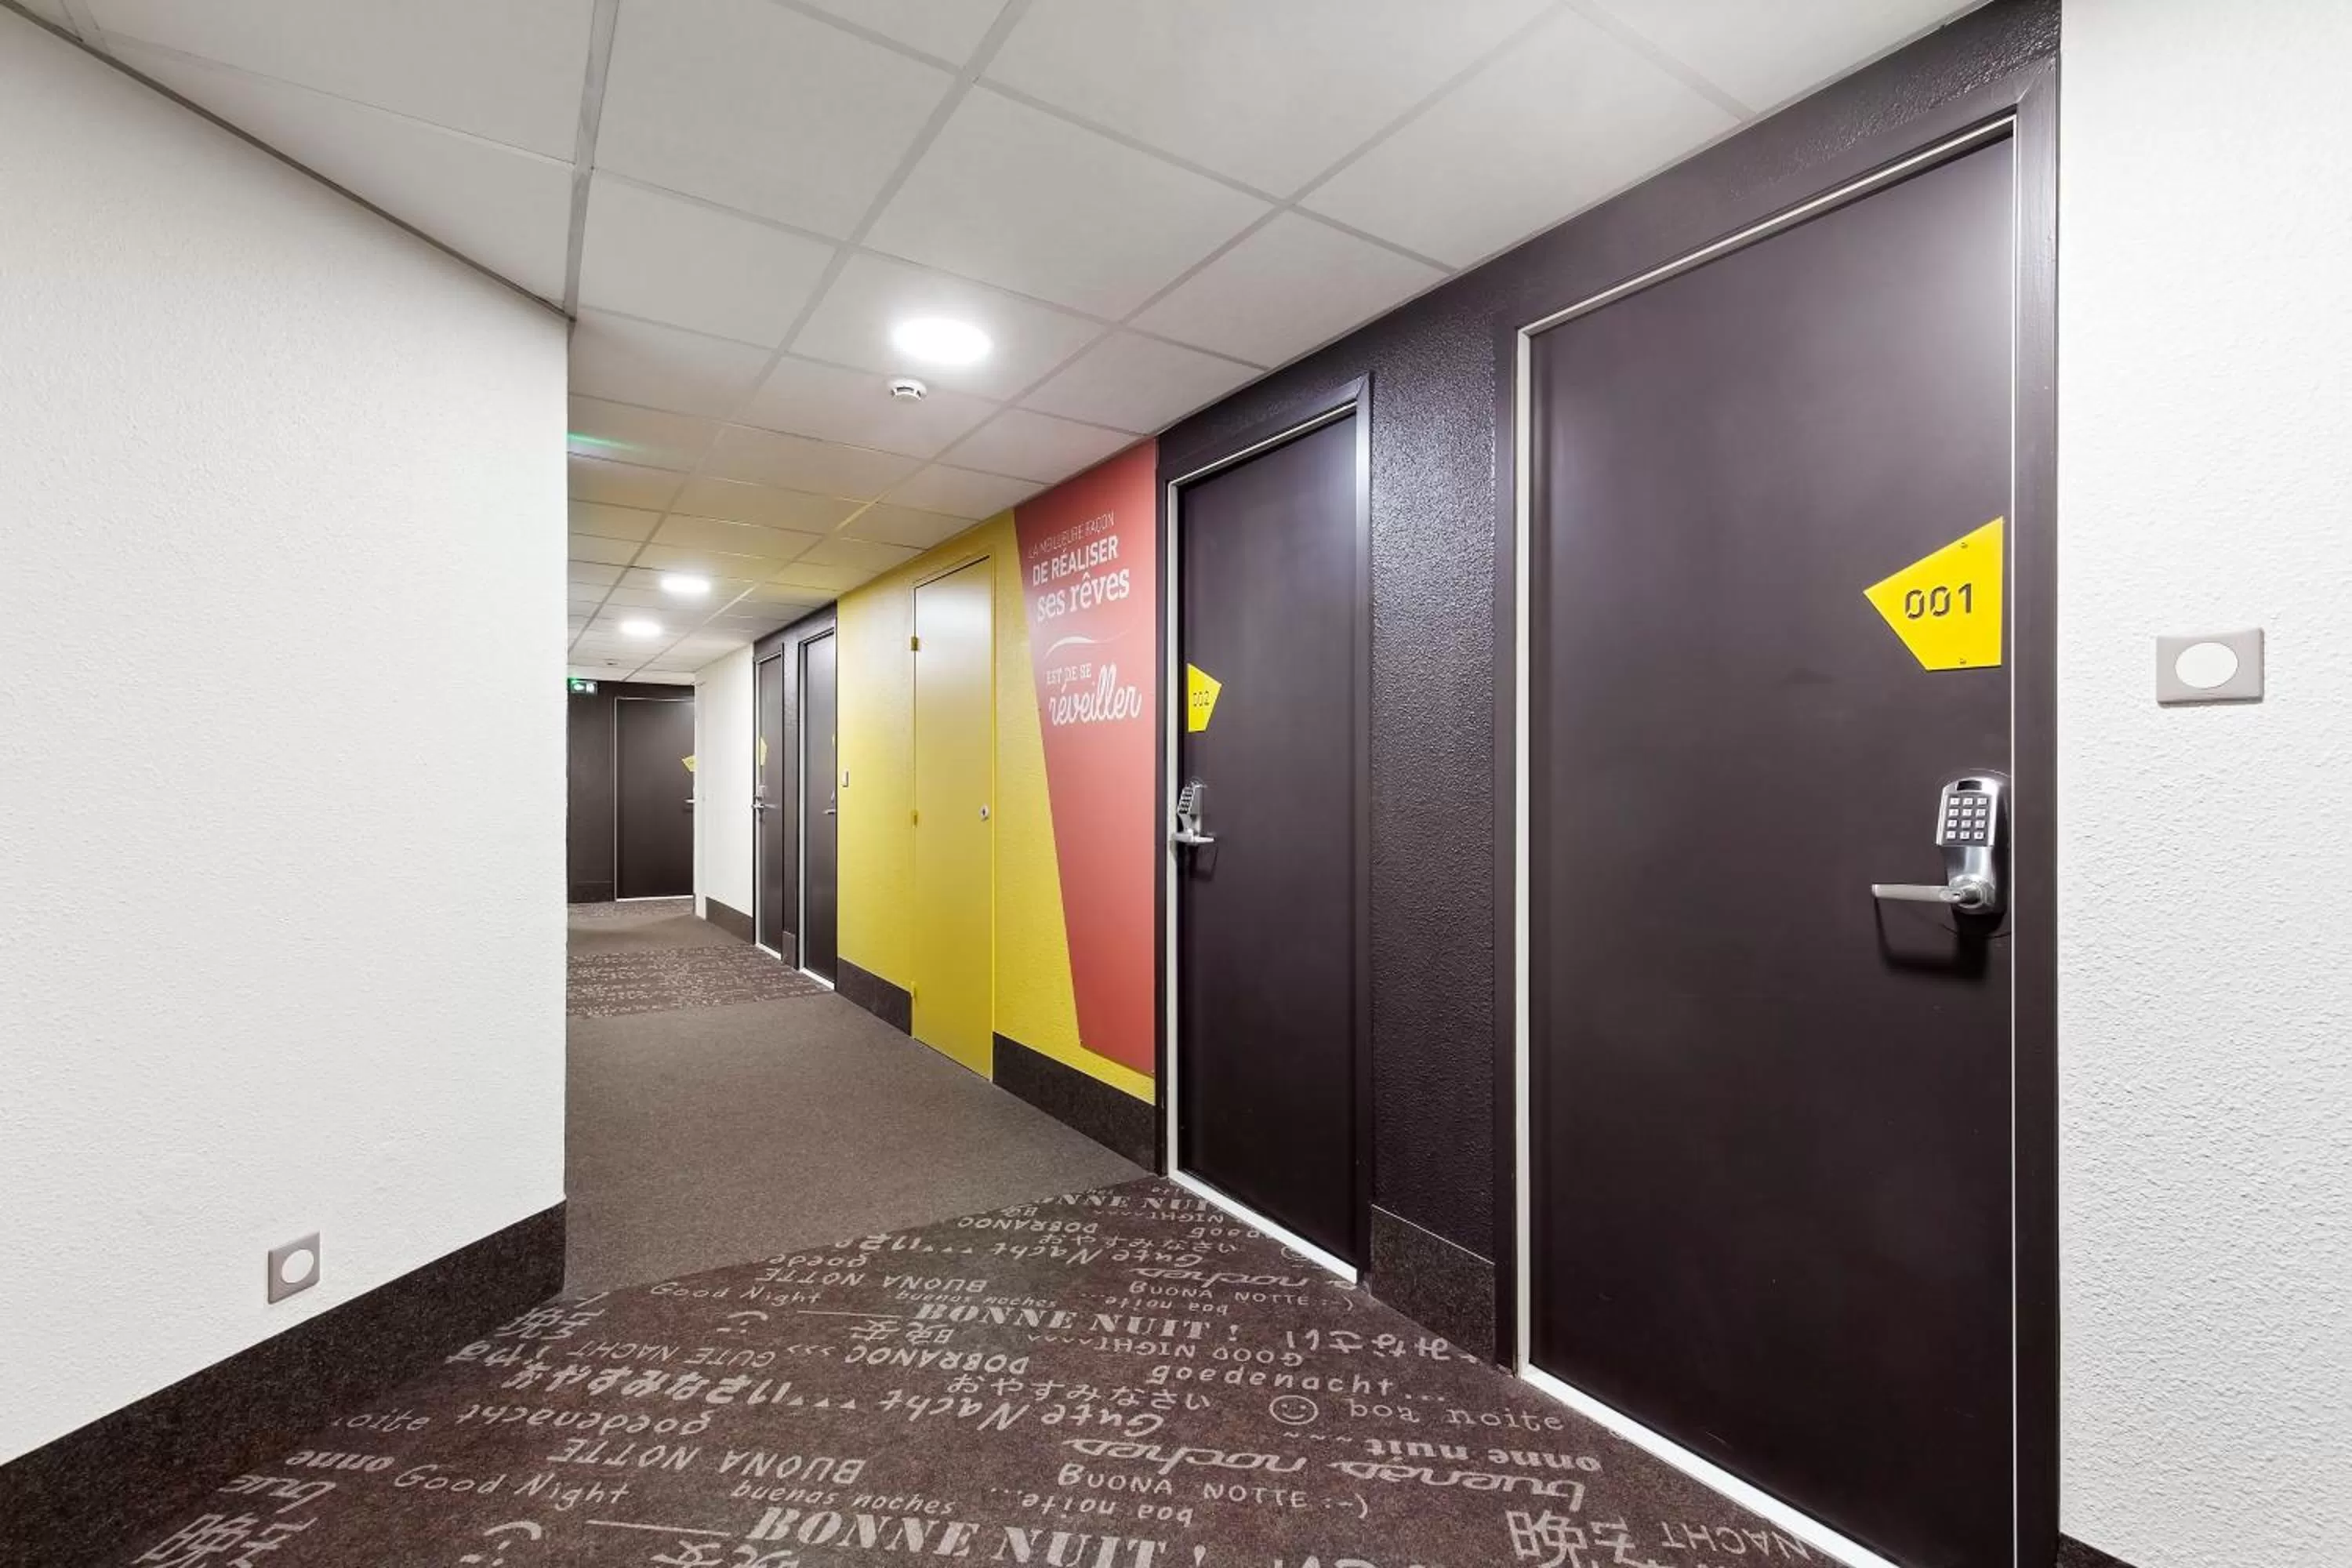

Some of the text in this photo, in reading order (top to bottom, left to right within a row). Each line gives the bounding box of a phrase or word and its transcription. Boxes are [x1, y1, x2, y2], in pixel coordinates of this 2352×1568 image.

[1033, 535, 1119, 586] DE RÉALISER
[1037, 568, 1130, 620] ses rêves
[1904, 583, 1973, 619] 001
[1049, 663, 1142, 726] réveiller
[957, 1218, 1098, 1233] DOBRANOC
[652, 1282, 821, 1307] Good Night
[755, 1268, 987, 1293] BUONA NOTTE
[913, 1304, 1078, 1330] BONNE
[1090, 1313, 1210, 1340] NUIT
[566, 1340, 776, 1368] GUTE NACHT
[845, 1345, 1030, 1375] DOBRANOC
[1213, 1346, 1303, 1367] GOOD
[456, 1404, 714, 1436] goedenacht
[880, 1391, 1165, 1438] Gute Nacht
[1348, 1399, 1565, 1432] boa noite
[547, 1438, 867, 1486] BUONA NOTTE
[394, 1465, 630, 1512] Good Night
[730, 1479, 956, 1516] buenas noches
[1203, 1483, 1308, 1509] NOTTE
[745, 1505, 980, 1559] BONNE
[1136, 1506, 1194, 1529] boa
